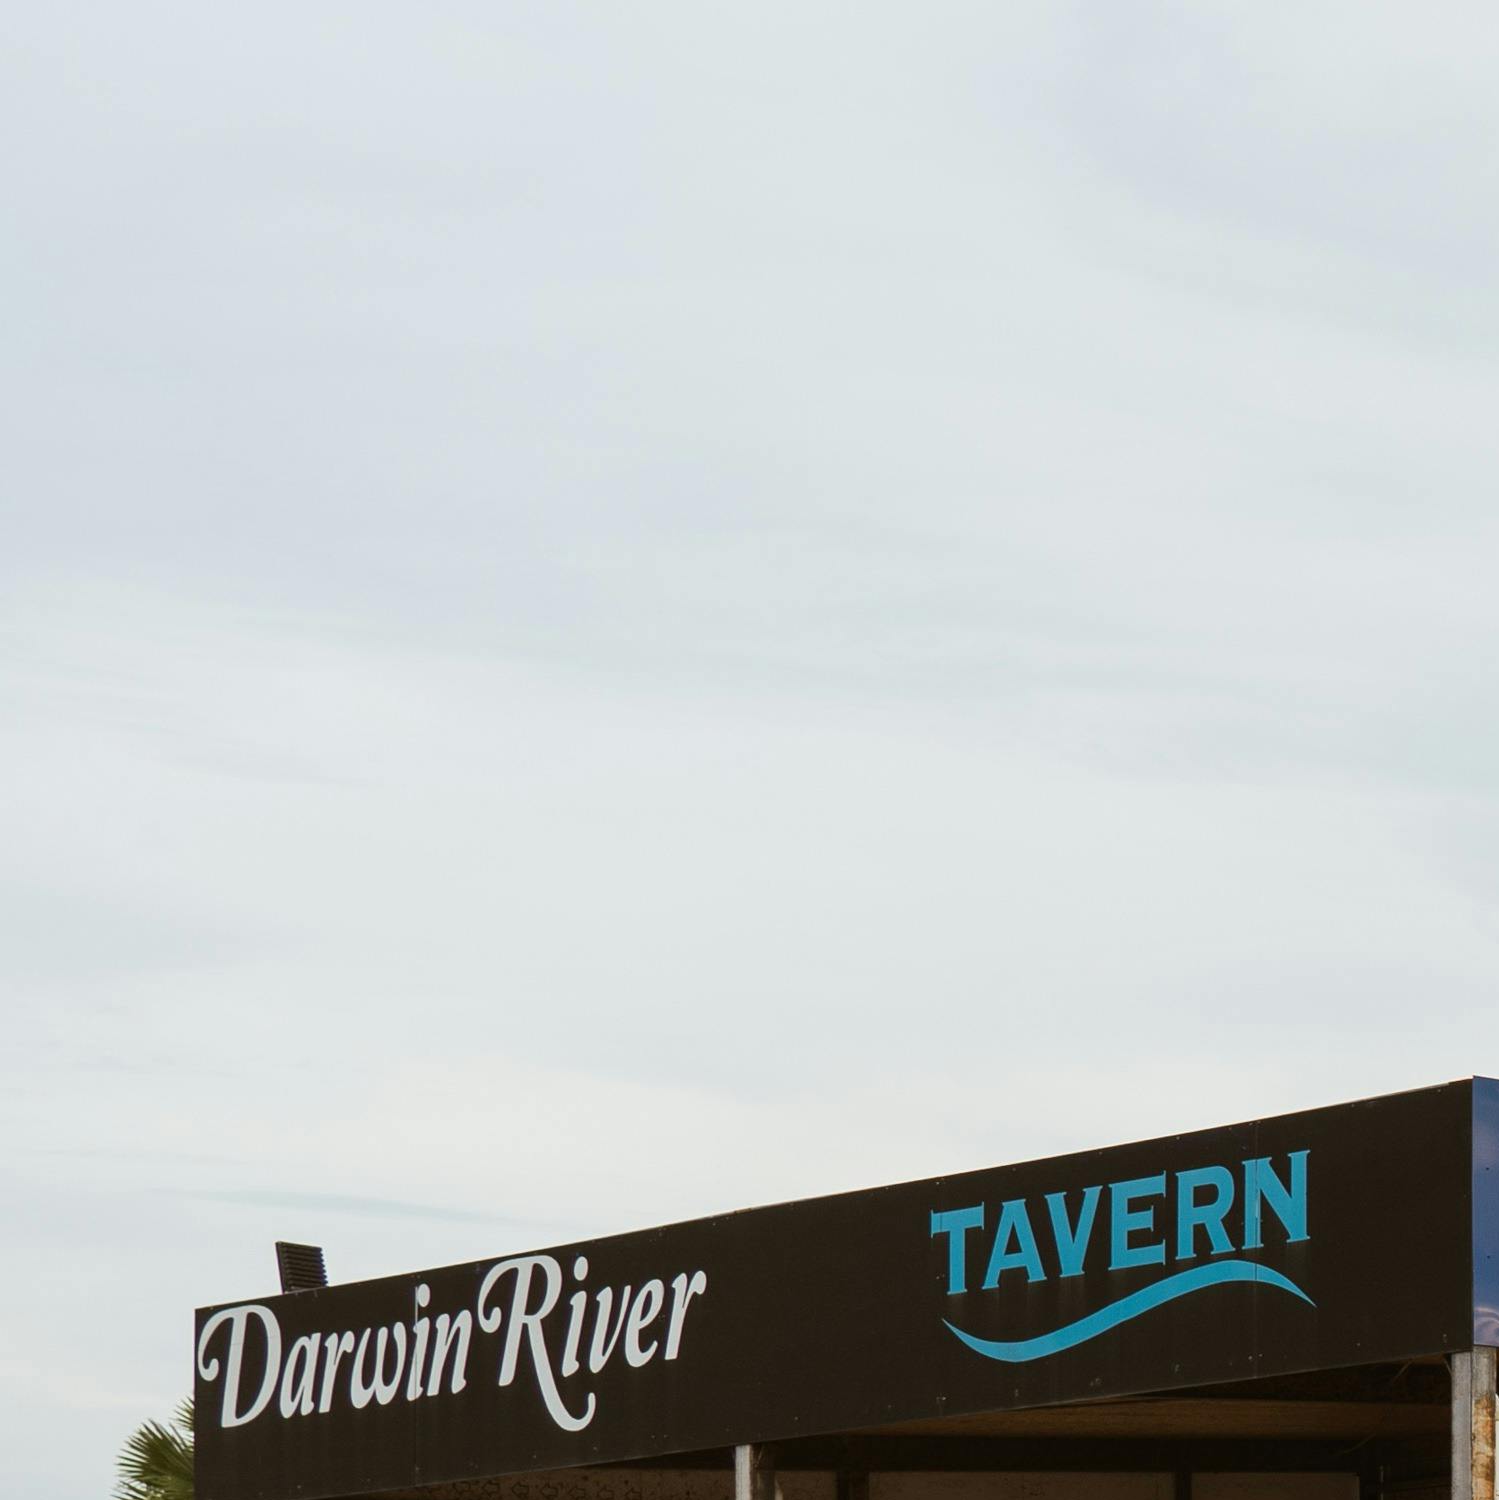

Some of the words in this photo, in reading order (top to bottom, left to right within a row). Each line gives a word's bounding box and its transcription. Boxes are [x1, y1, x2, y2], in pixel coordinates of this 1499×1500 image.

[930, 1149, 1311, 1295] TAVERN
[198, 1283, 473, 1428] Darwin
[479, 1255, 707, 1431] River
